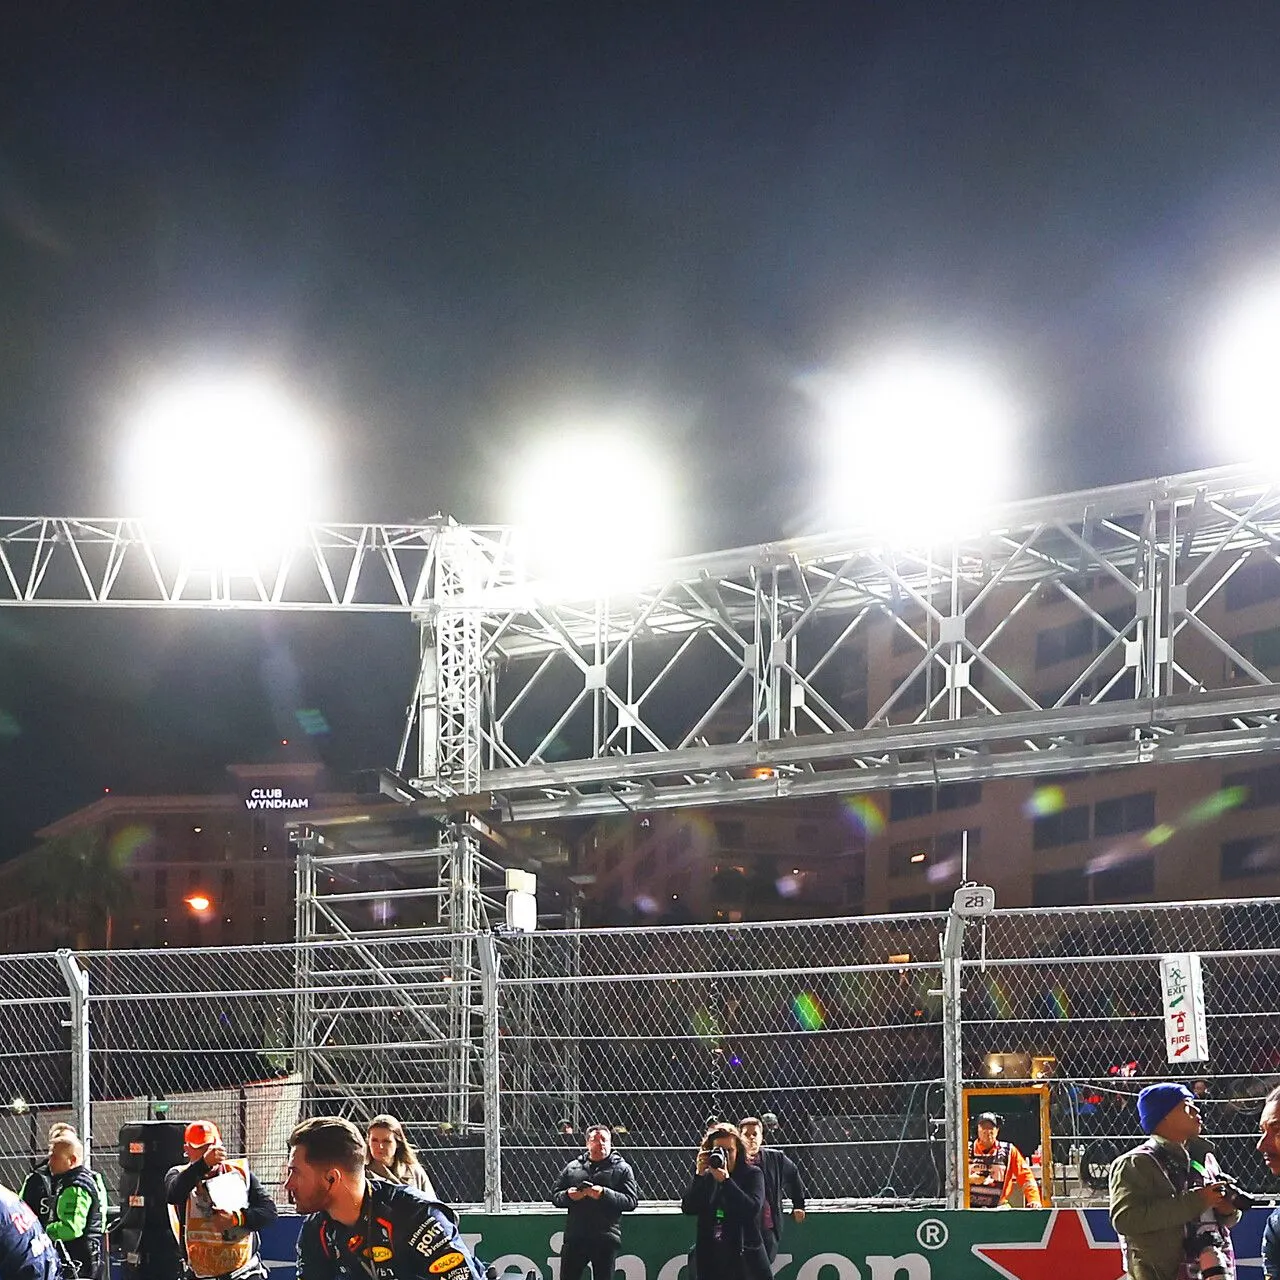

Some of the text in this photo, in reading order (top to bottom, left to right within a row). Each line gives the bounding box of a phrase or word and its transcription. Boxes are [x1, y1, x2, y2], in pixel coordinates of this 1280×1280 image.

[251, 788, 283, 799] CLUB
[245, 798, 309, 809] WYNDHAM
[965, 895, 984, 908] 28
[1167, 985, 1187, 996] EXIT
[1171, 1034, 1191, 1045] FIRE
[407, 1216, 437, 1247] infinitum
[415, 1221, 445, 1257] ROKT
[438, 1255, 462, 1269] RAUCH
[447, 1266, 470, 1280] ARCTIC
